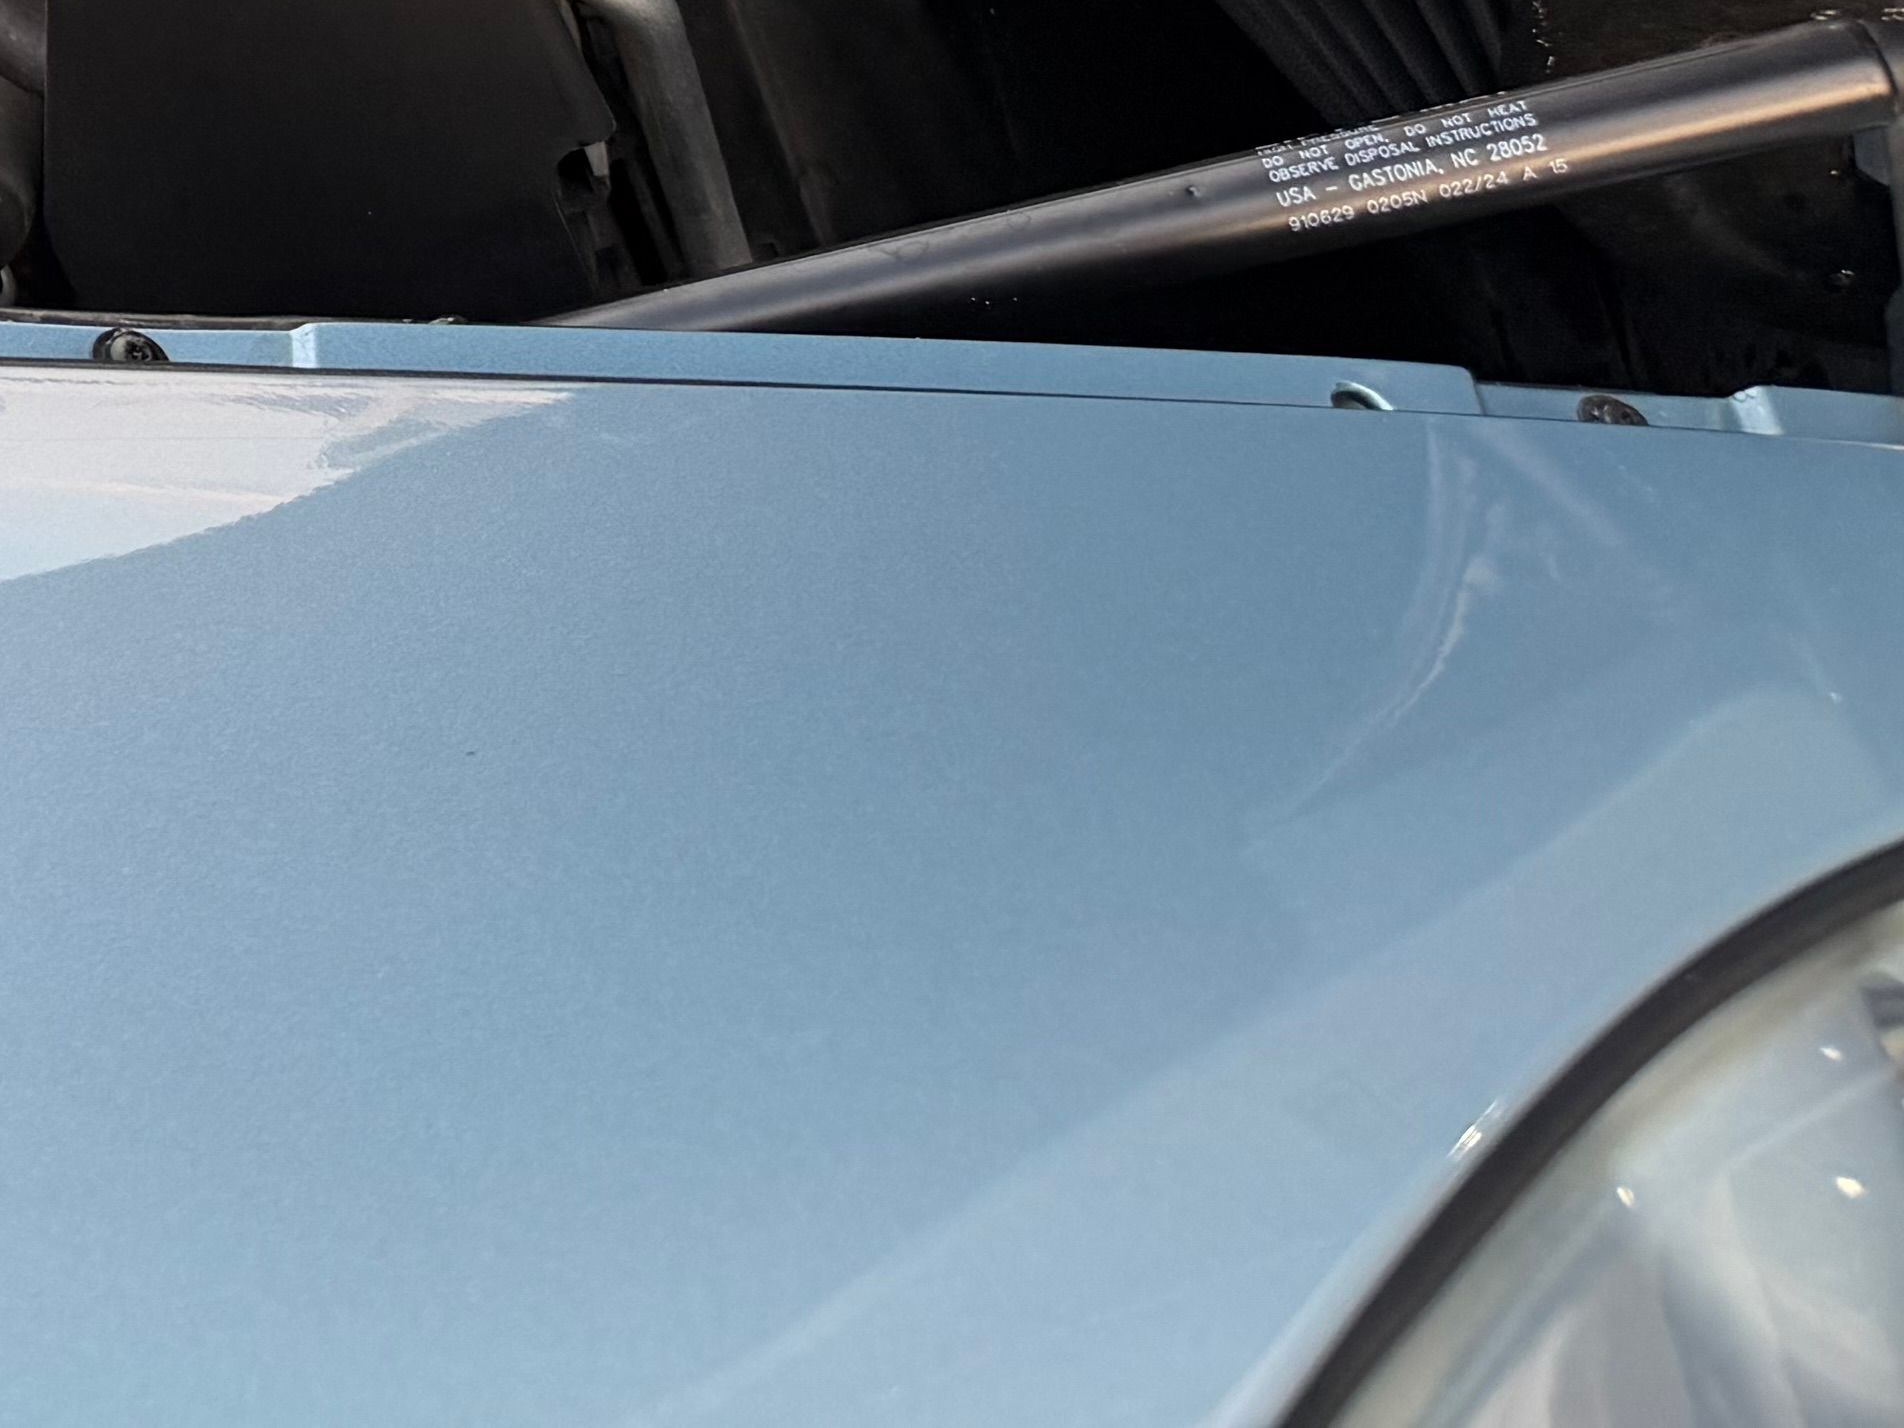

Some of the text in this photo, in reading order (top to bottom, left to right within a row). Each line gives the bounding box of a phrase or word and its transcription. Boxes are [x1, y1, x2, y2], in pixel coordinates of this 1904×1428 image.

[1262, 100, 1529, 169] DO NOT OPEN. DO NOT HEAT
[1269, 113, 1539, 183] OBSERVE DISPOSAL INSTRUCTIONS
[1276, 186, 1316, 207] USA
[1348, 158, 1445, 191] GASTONIA,
[1450, 148, 1479, 169] NC
[1486, 133, 1549, 162] 28052
[1288, 158, 1569, 232] 910629 0205N 022/24 A 15
